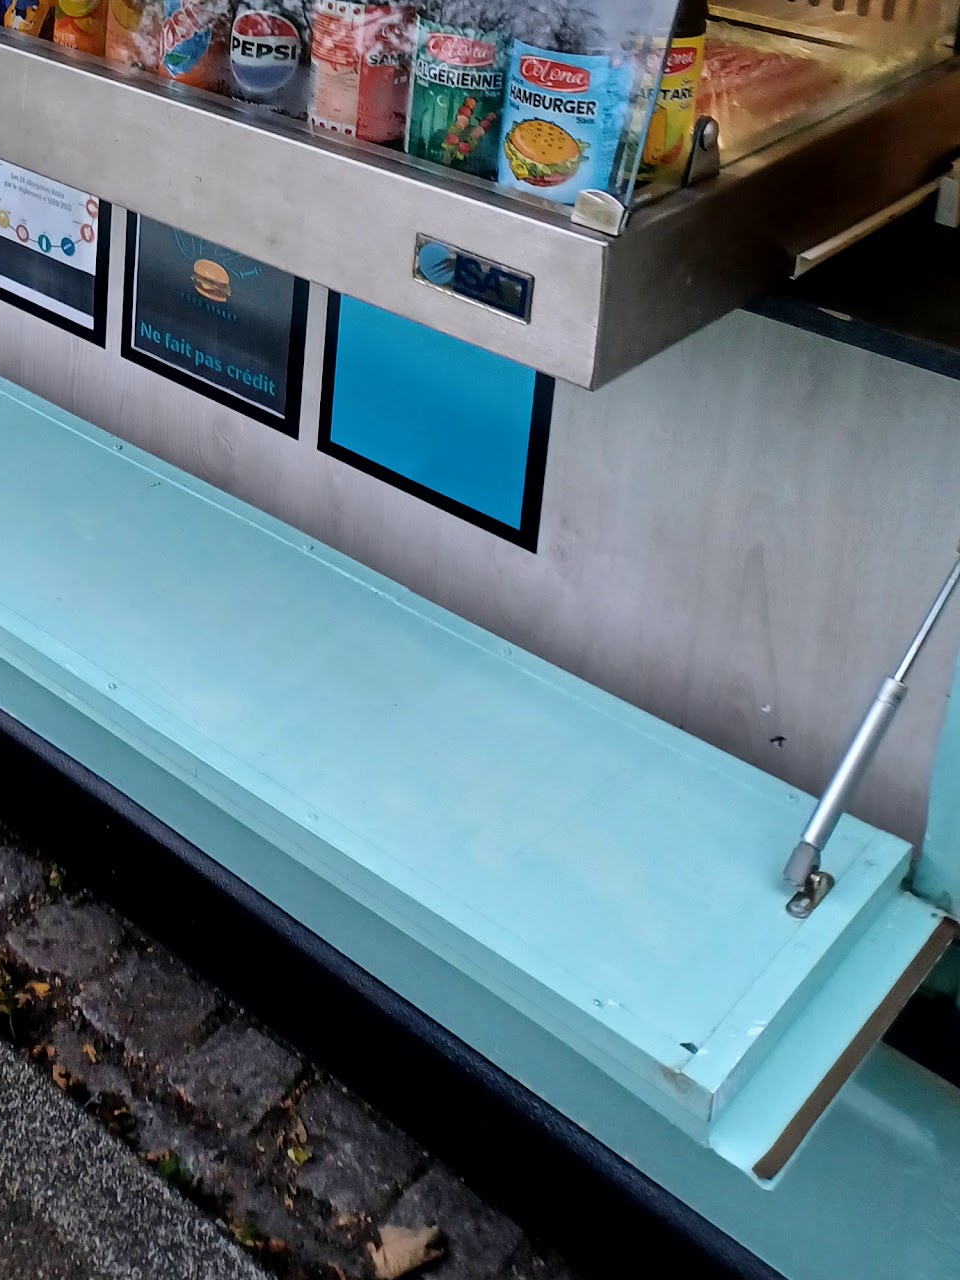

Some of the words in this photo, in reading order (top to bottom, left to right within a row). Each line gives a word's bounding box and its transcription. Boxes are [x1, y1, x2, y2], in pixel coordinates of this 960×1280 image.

[231, 36, 298, 61] PEPSI
[521, 57, 588, 87] Colona
[510, 84, 597, 116] HAMBURGER
[140, 321, 161, 344] Ne
[164, 332, 192, 358] fait
[194, 349, 223, 373] pas
[226, 363, 276, 398] crédit
